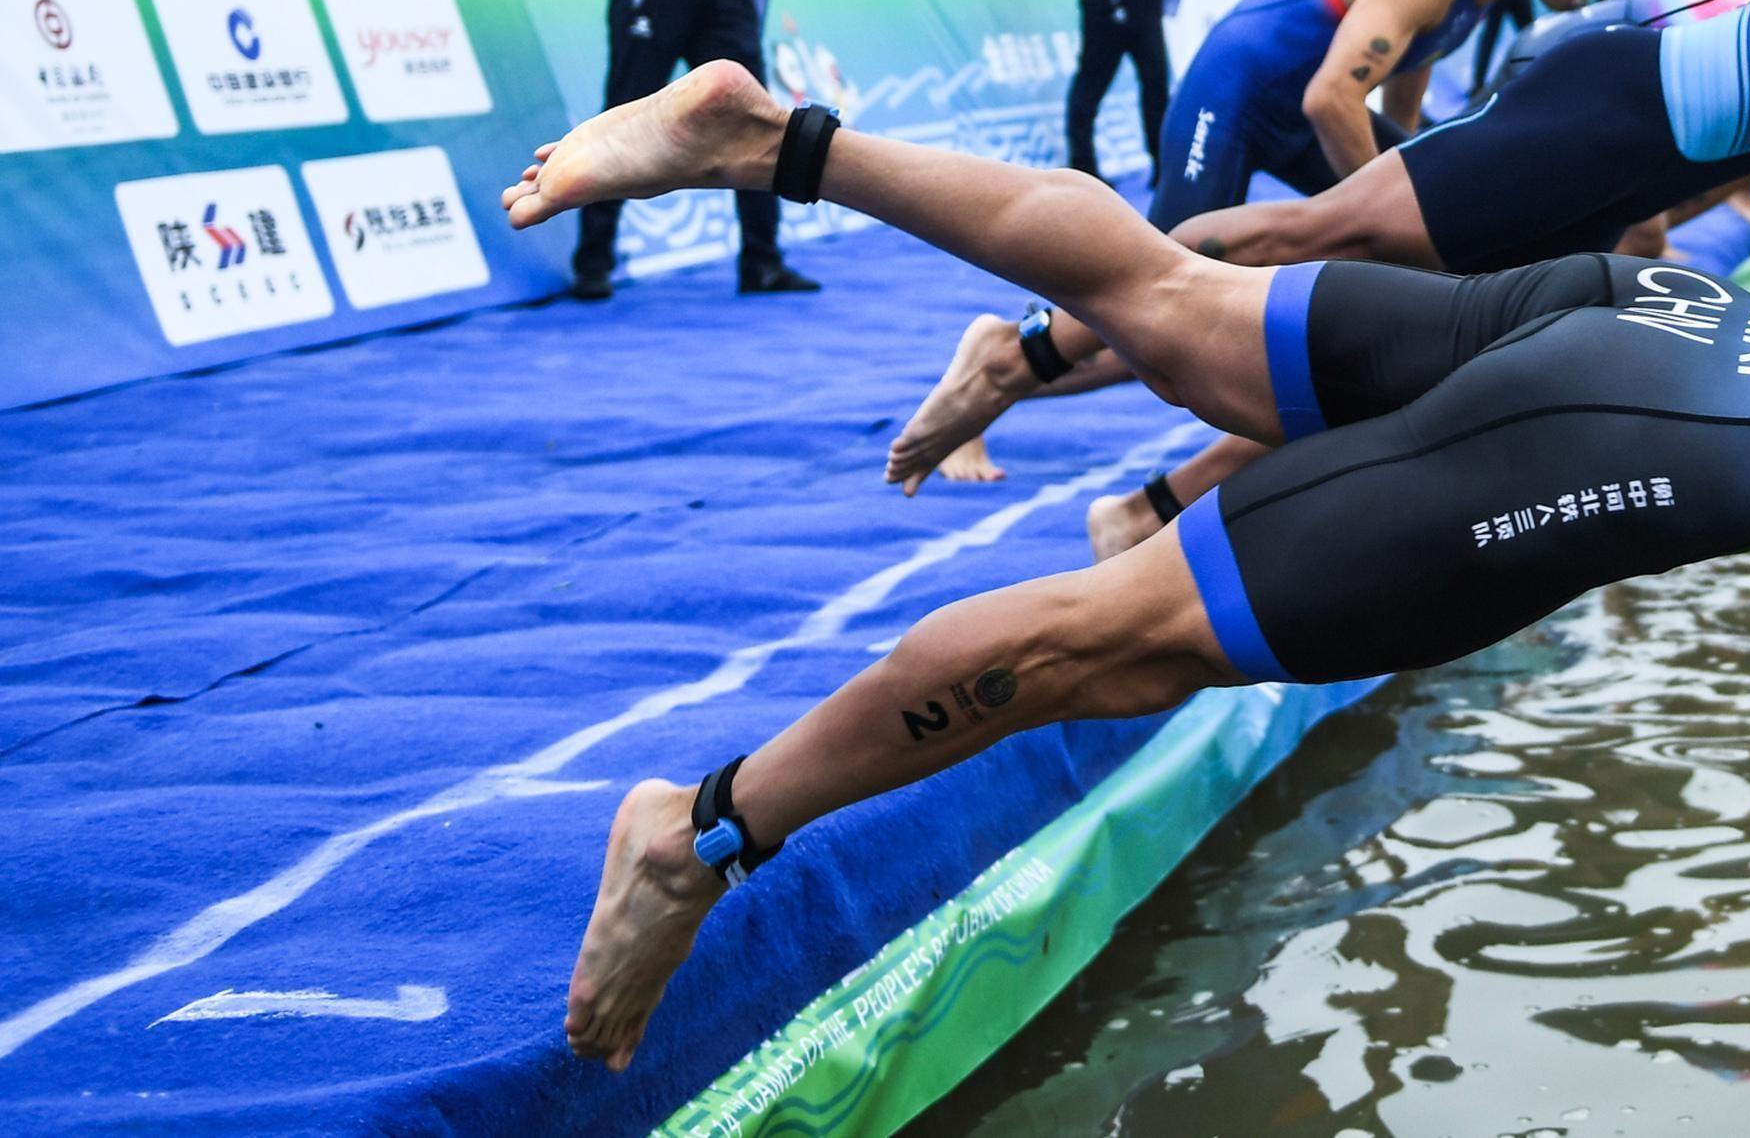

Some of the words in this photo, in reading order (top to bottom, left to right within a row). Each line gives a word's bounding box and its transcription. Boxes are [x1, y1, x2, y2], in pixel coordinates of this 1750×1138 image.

[1615, 266, 1734, 345] CHN
[902, 700, 949, 741] 2
[737, 1048, 806, 1115] GAMES
[800, 1029, 825, 1067] OF
[819, 1008, 856, 1050] THE
[852, 946, 935, 1030] PEOPLE'S
[930, 895, 1003, 966] RUBLIC
